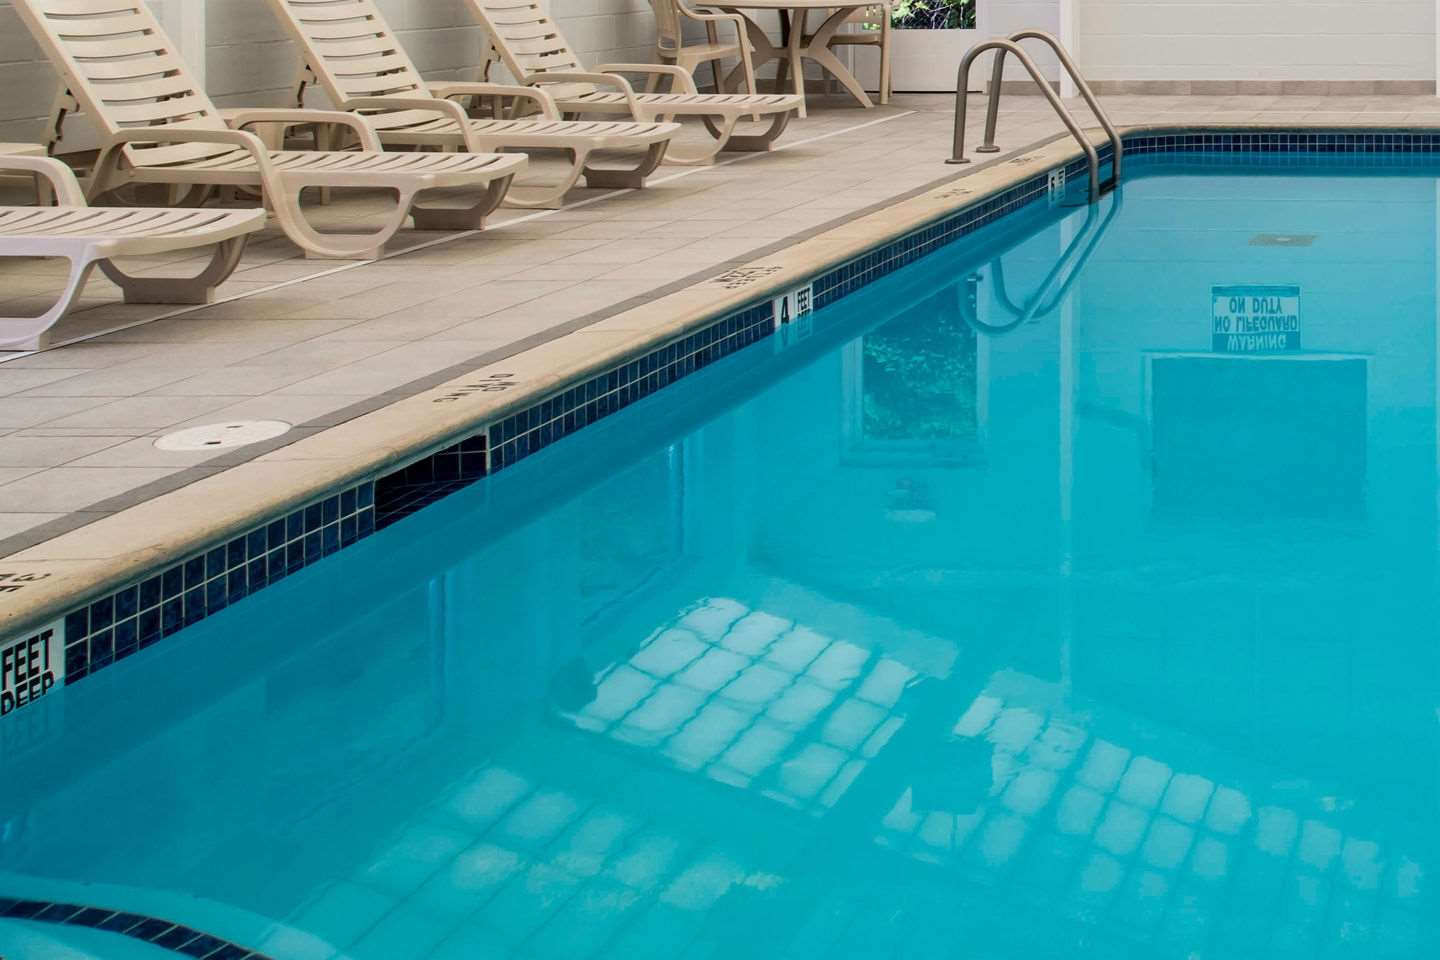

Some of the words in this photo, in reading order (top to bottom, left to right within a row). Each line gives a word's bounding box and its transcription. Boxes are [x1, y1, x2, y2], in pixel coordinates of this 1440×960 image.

[781, 296, 789, 324] 4
[2, 629, 53, 690] FEET
[0, 671, 54, 717] DEEP
